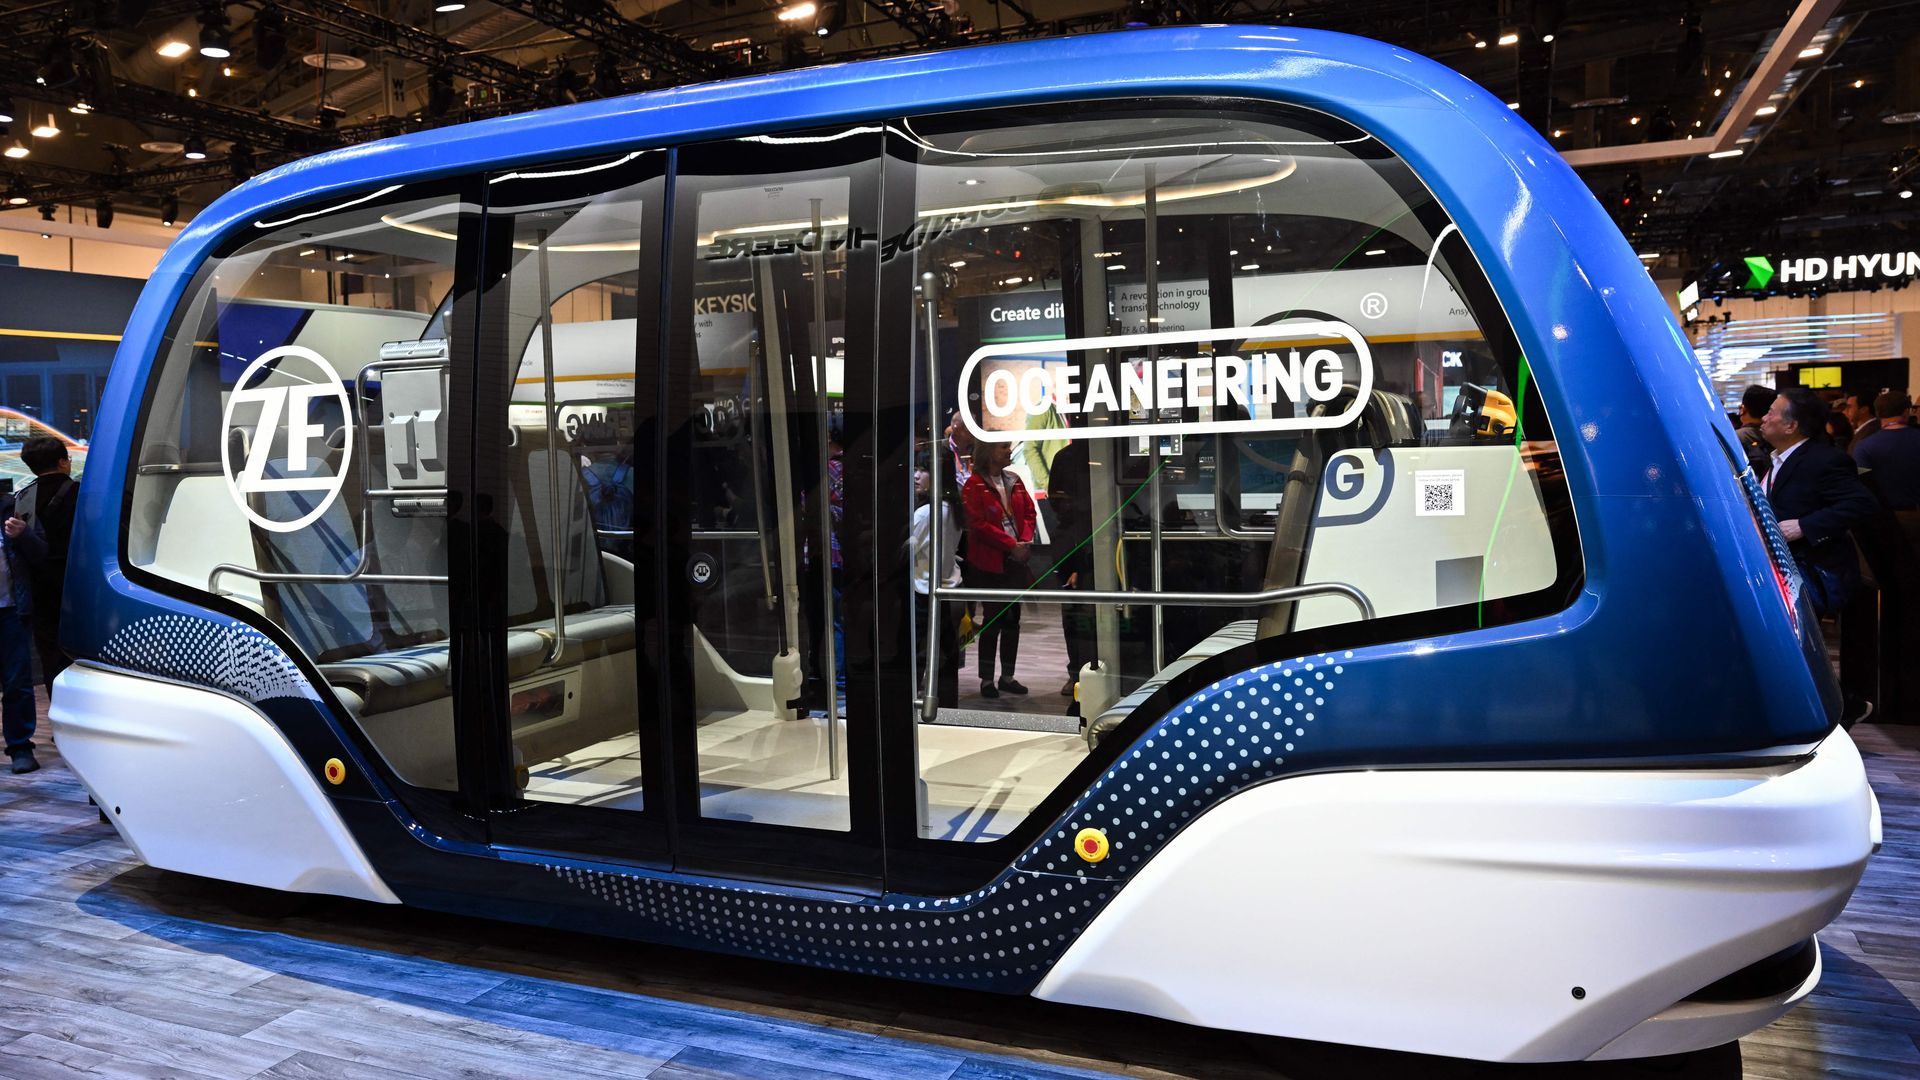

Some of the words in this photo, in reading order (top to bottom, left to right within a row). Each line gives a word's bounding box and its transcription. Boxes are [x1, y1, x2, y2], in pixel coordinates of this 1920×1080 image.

[1780, 257, 1828, 283] HD
[1833, 251, 1920, 280] HYUN
[1121, 292, 1128, 301] A
[1129, 289, 1174, 301] revoion
[1176, 288, 1184, 297] in
[990, 305, 1041, 323] Create
[1156, 301, 1201, 311] chnology
[698, 319, 713, 328] with
[984, 348, 1344, 419] OCEANEERING
[226, 376, 350, 496] ZF
